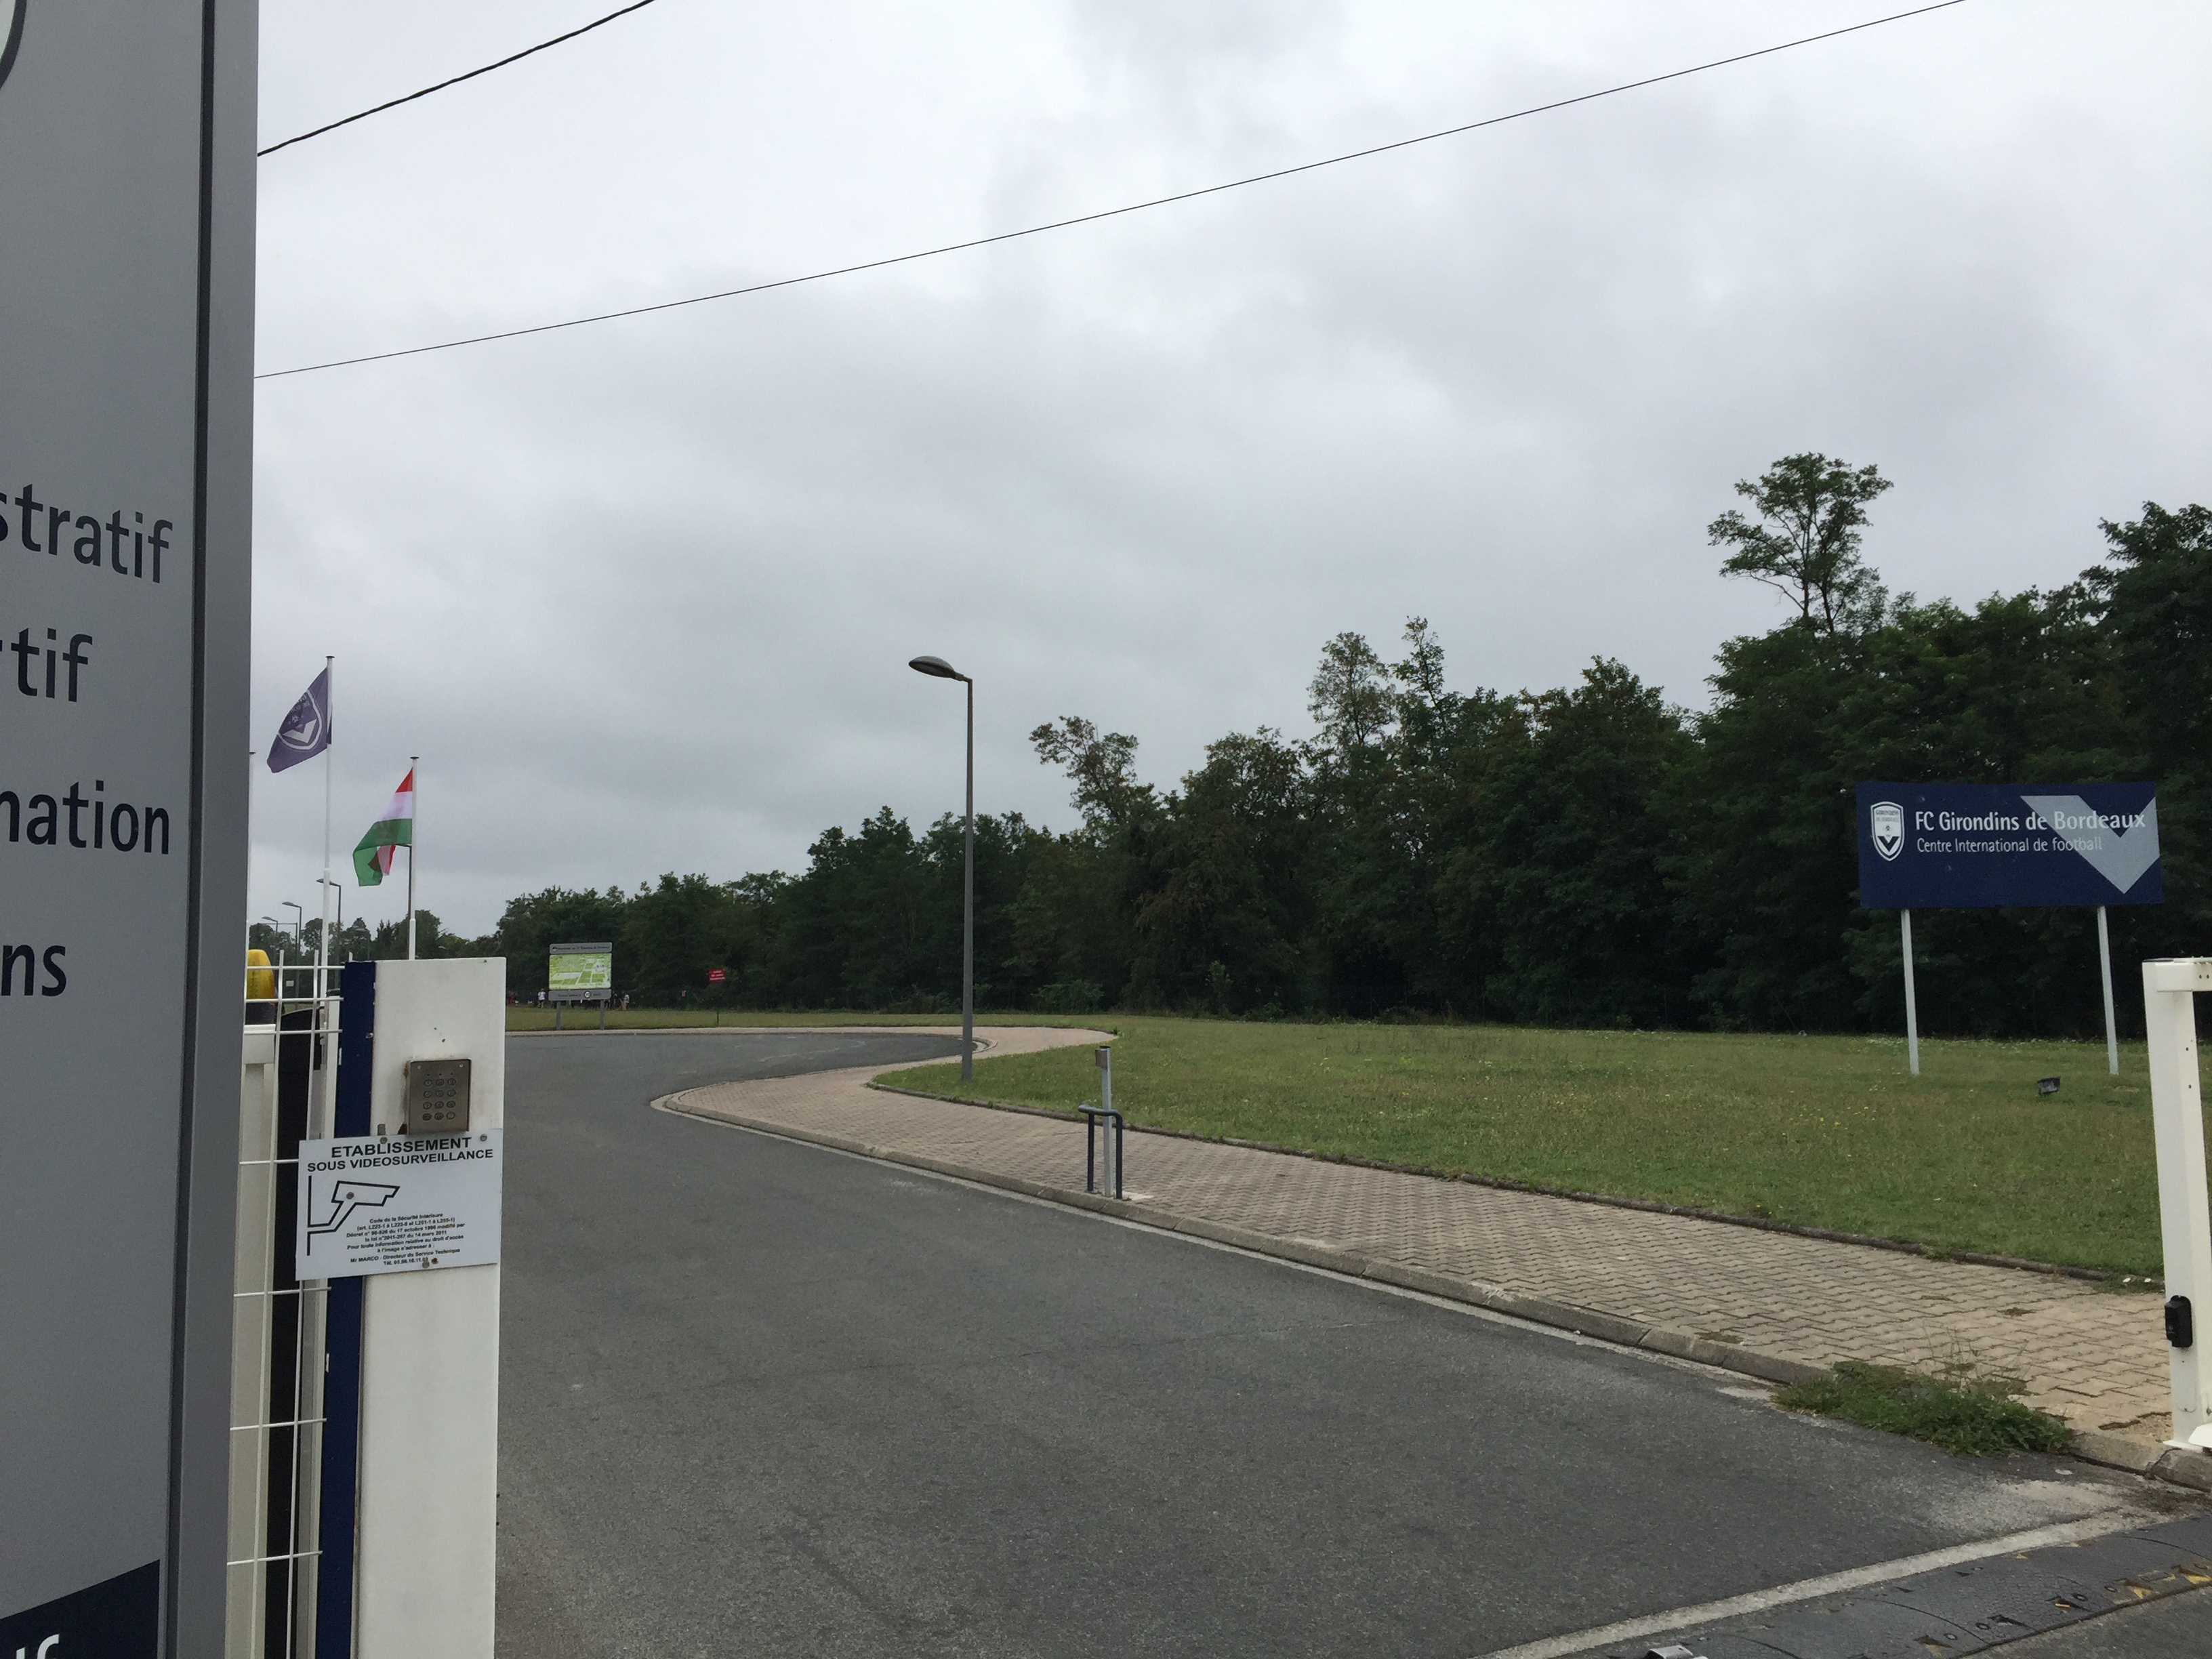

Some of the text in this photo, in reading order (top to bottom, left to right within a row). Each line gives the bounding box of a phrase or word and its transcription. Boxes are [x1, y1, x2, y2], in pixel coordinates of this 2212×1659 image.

[0, 628, 93, 702] tif
[1915, 811, 2146, 832] FC Girondins de Bordeaux
[1917, 837, 2103, 853] Centre International de football
[331, 1137, 472, 1158] ETABLISSEMENT
[307, 1149, 493, 1172] SOUS VIDEOSURVEILLANCE
